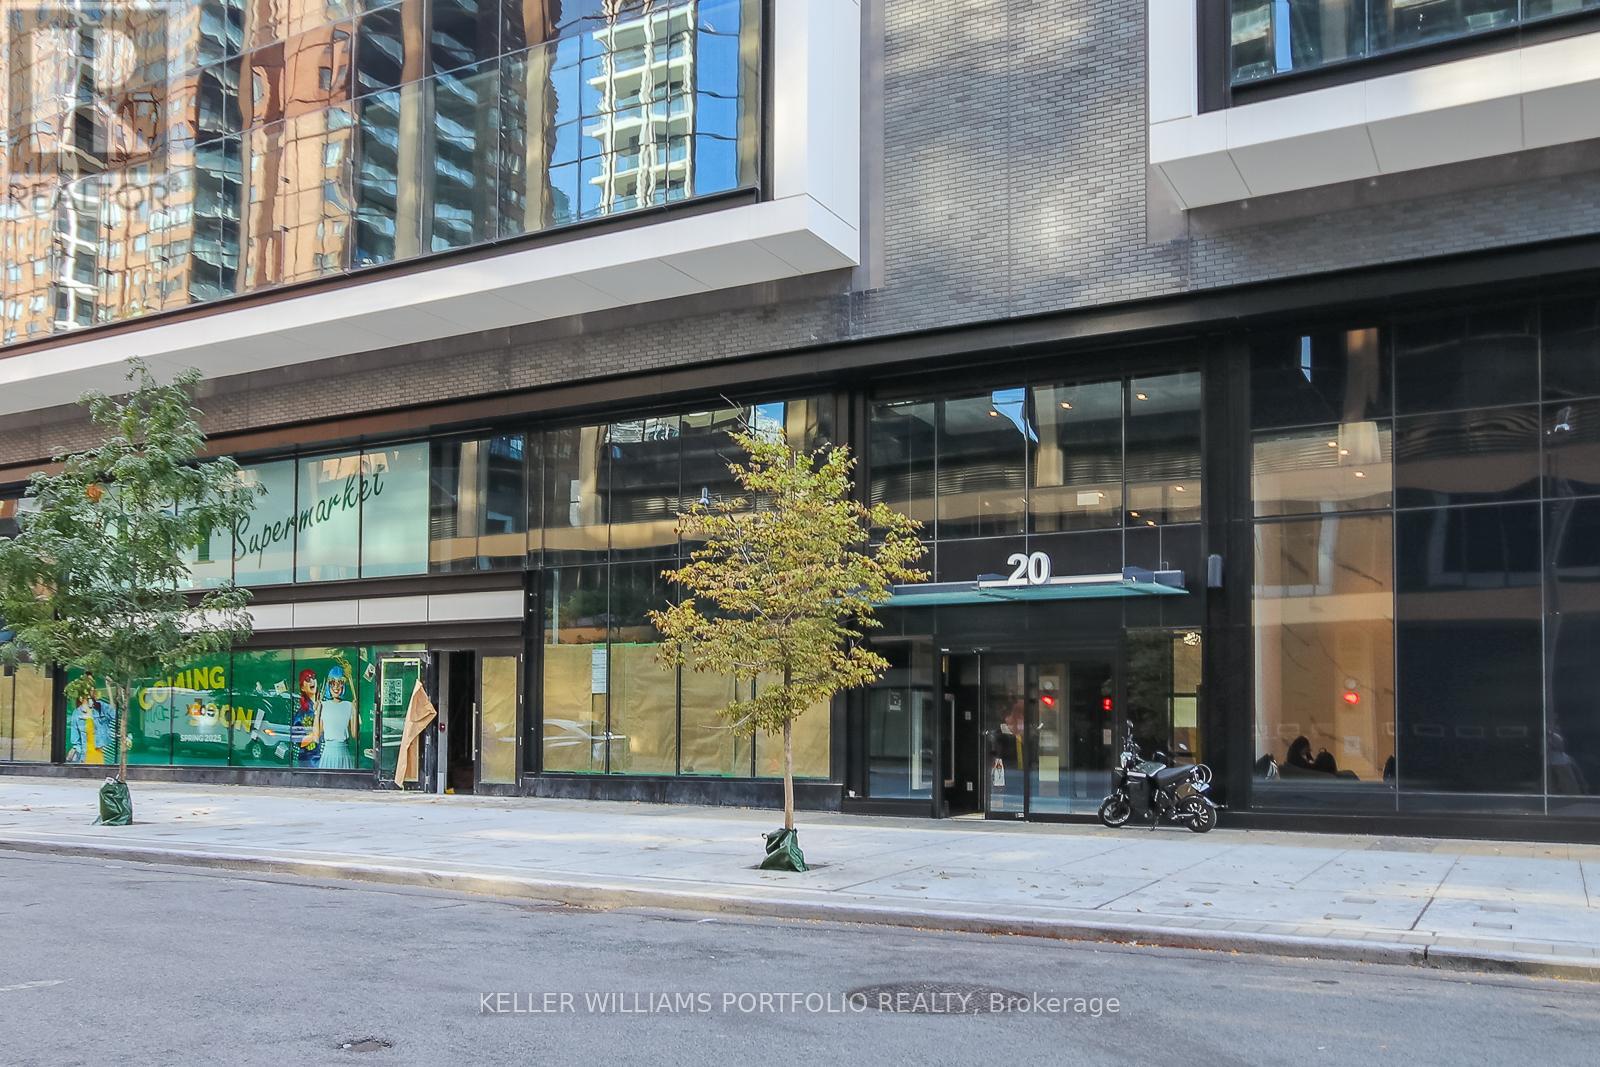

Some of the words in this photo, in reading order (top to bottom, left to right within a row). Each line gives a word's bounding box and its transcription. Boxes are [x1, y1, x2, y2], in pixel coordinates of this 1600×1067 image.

[234, 463, 385, 569] Supermarket
[1007, 551, 1051, 585] 20
[180, 734, 204, 742] SPRING
[205, 734, 222, 743] 2025
